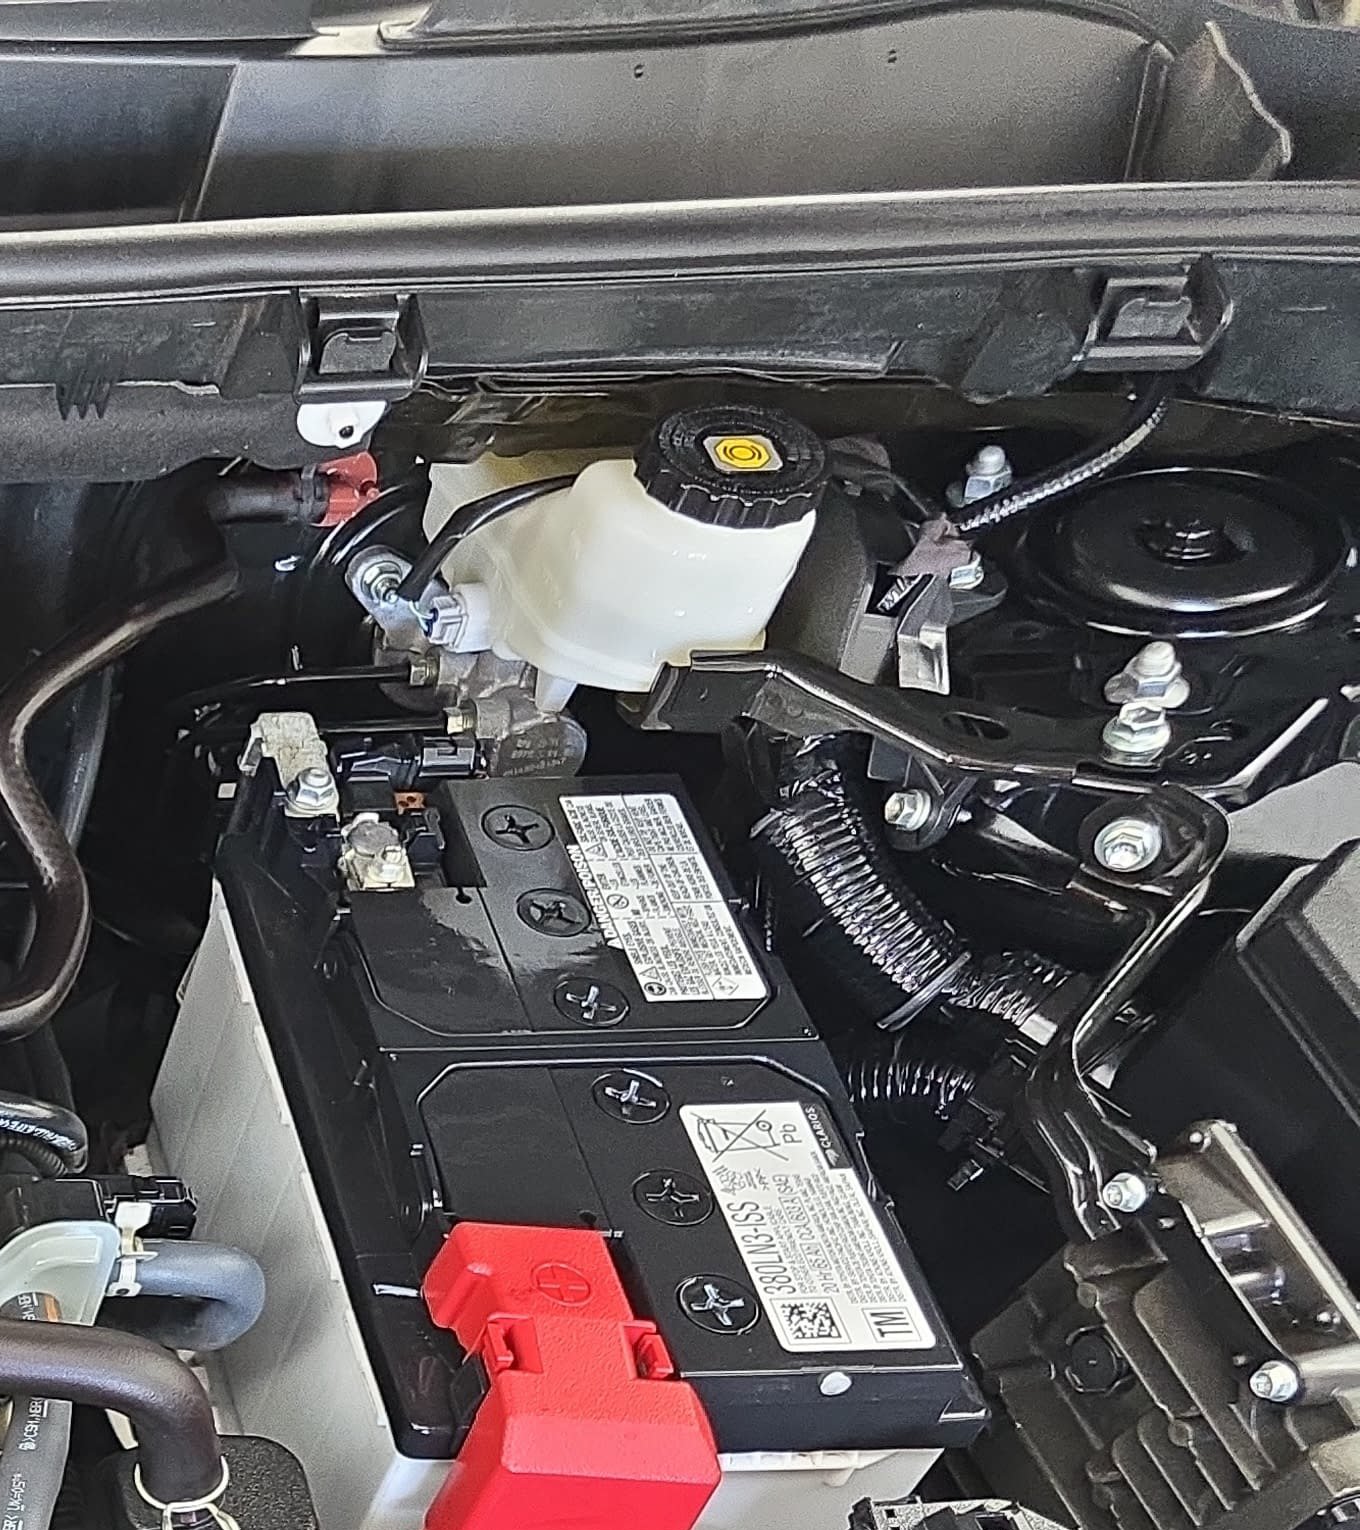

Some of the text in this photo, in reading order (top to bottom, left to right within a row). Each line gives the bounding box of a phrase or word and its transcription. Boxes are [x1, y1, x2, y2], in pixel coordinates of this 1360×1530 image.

[776, 1123, 802, 1143] Pb
[803, 1107, 833, 1148] CLARIOS
[725, 1201, 798, 1294] 380LN3-ISS
[869, 1310, 915, 1337] TM
